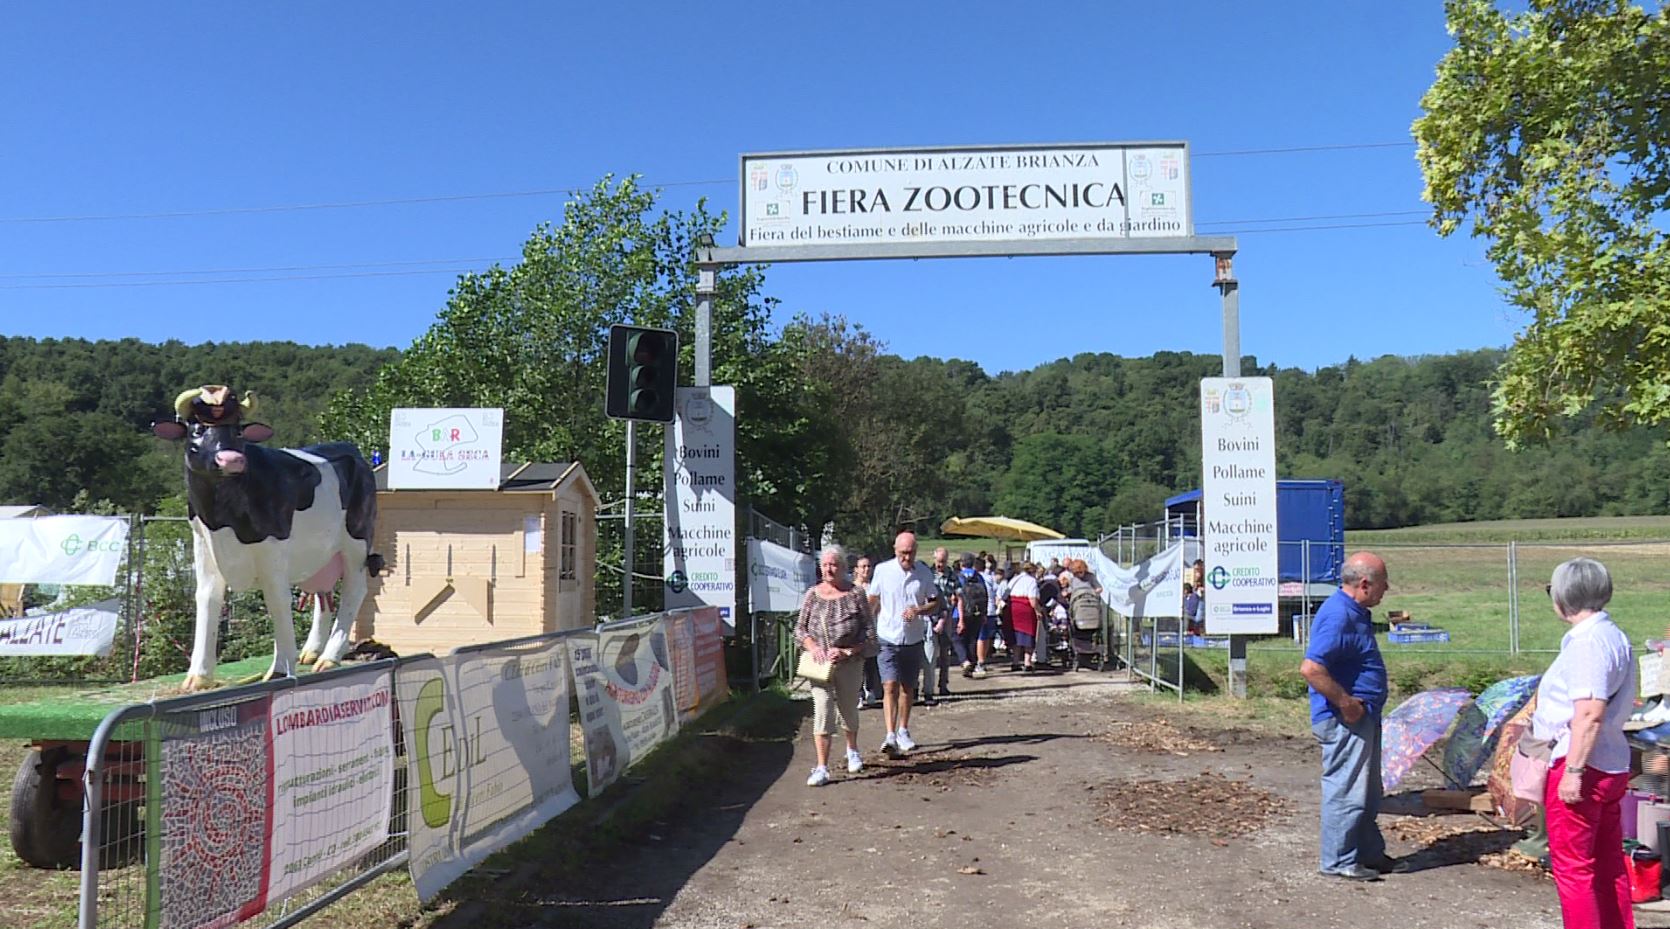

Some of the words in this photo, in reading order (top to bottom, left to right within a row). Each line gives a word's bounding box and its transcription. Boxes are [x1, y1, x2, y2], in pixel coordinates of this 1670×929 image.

[827, 159, 908, 174] COMUNE
[914, 158, 932, 170] DI
[939, 156, 1011, 170] ALZATE
[1016, 154, 1100, 169] BRIANZA
[802, 188, 891, 215] FIERA
[902, 182, 1125, 213] ZOOTECNICA
[750, 227, 785, 242] Fiera
[790, 225, 812, 240] del
[817, 224, 883, 240] bestiame
[888, 226, 896, 236] e
[901, 222, 937, 237] delle
[942, 220, 1016, 236] macchine
[1018, 219, 1079, 237] agricole
[1083, 222, 1092, 232] e
[1097, 218, 1115, 232] da
[1119, 217, 1181, 235] giardino
[432, 428, 461, 442] BAR
[679, 444, 720, 459] Bovini
[1218, 436, 1259, 452] Bovini
[674, 471, 725, 486] Pollame
[1213, 464, 1265, 479] Pollame
[683, 498, 716, 513] Suini
[1223, 491, 1256, 507] Suini
[668, 525, 732, 540] Macchine
[1208, 519, 1273, 534] Macchine
[88, 540, 119, 552] BCC
[673, 543, 726, 561] agricole
[1214, 537, 1268, 557] agricole
[690, 572, 718, 581] CREDITO
[1232, 567, 1260, 577] CREDITO
[690, 582, 734, 591] COOPERATIVO
[1232, 577, 1277, 587] COOPERATIVO
